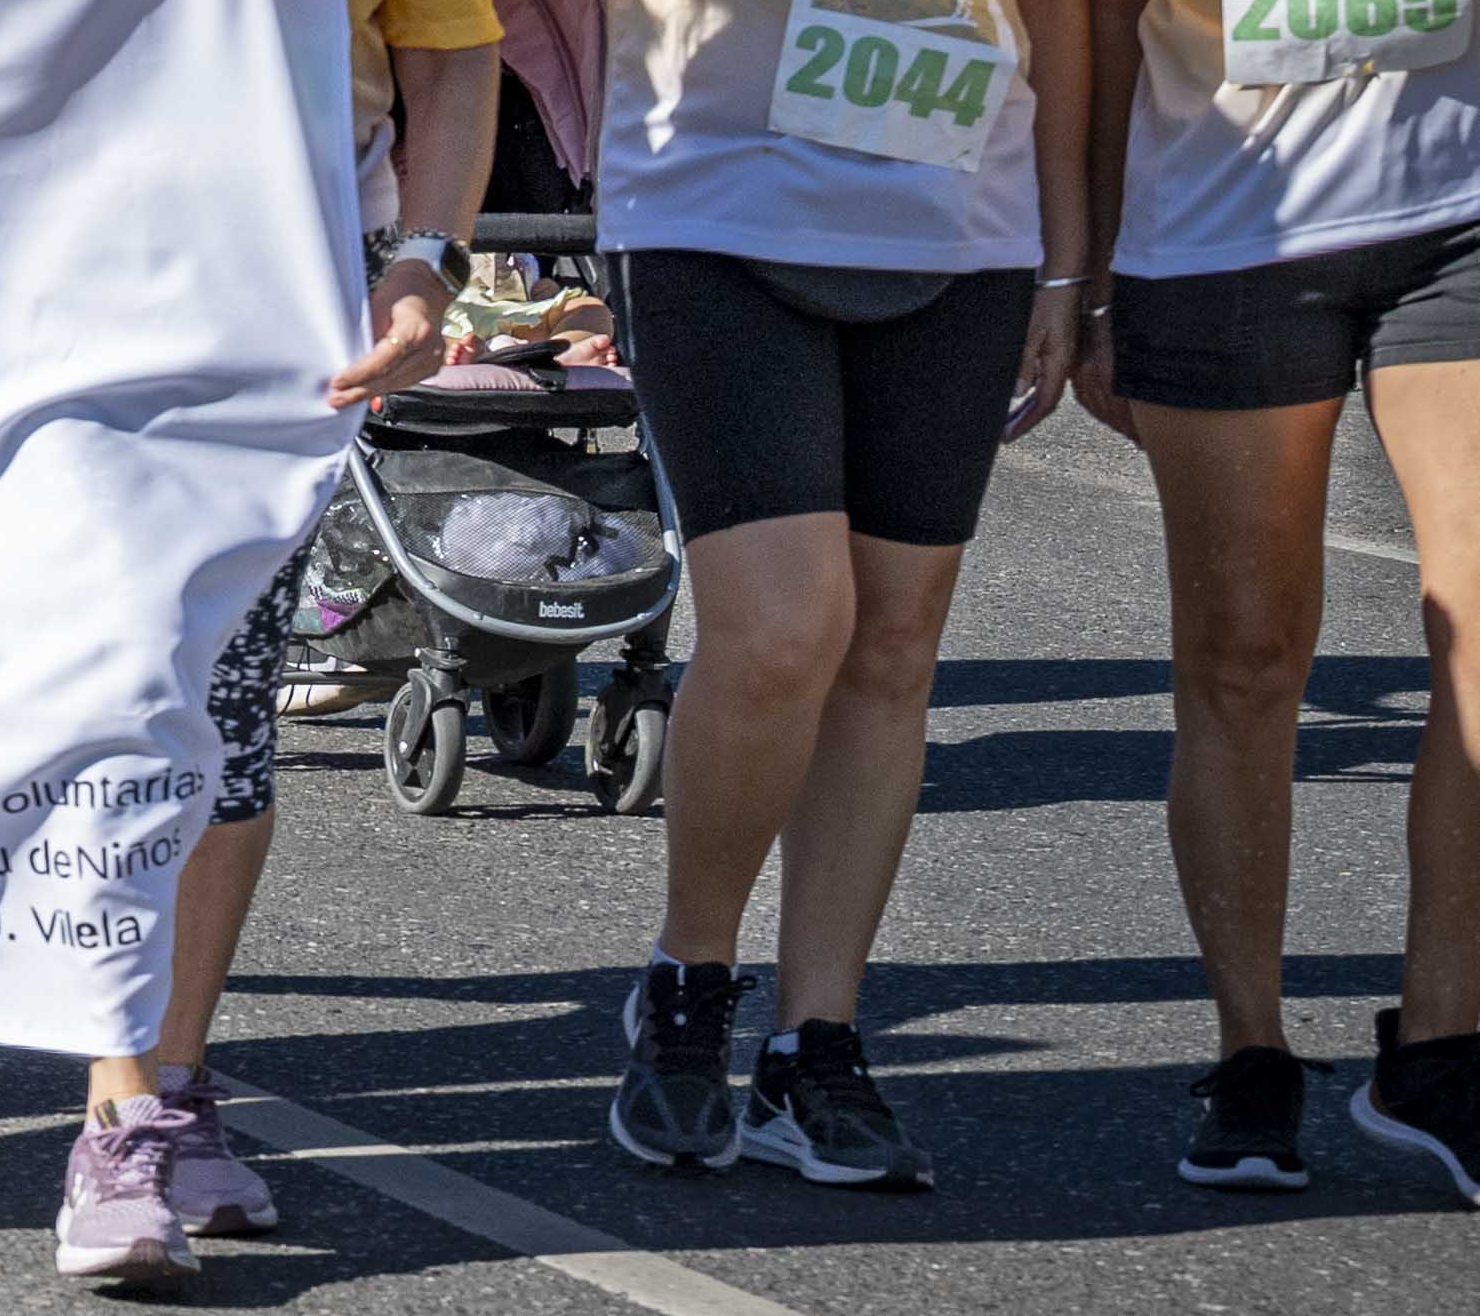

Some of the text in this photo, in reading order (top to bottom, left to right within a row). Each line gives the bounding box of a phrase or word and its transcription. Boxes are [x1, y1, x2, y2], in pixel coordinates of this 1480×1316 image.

[786, 24, 997, 128] 2044
[539, 601, 585, 618] bebesit
[28, 839, 72, 880] de
[29, 904, 144, 951] Vilela
